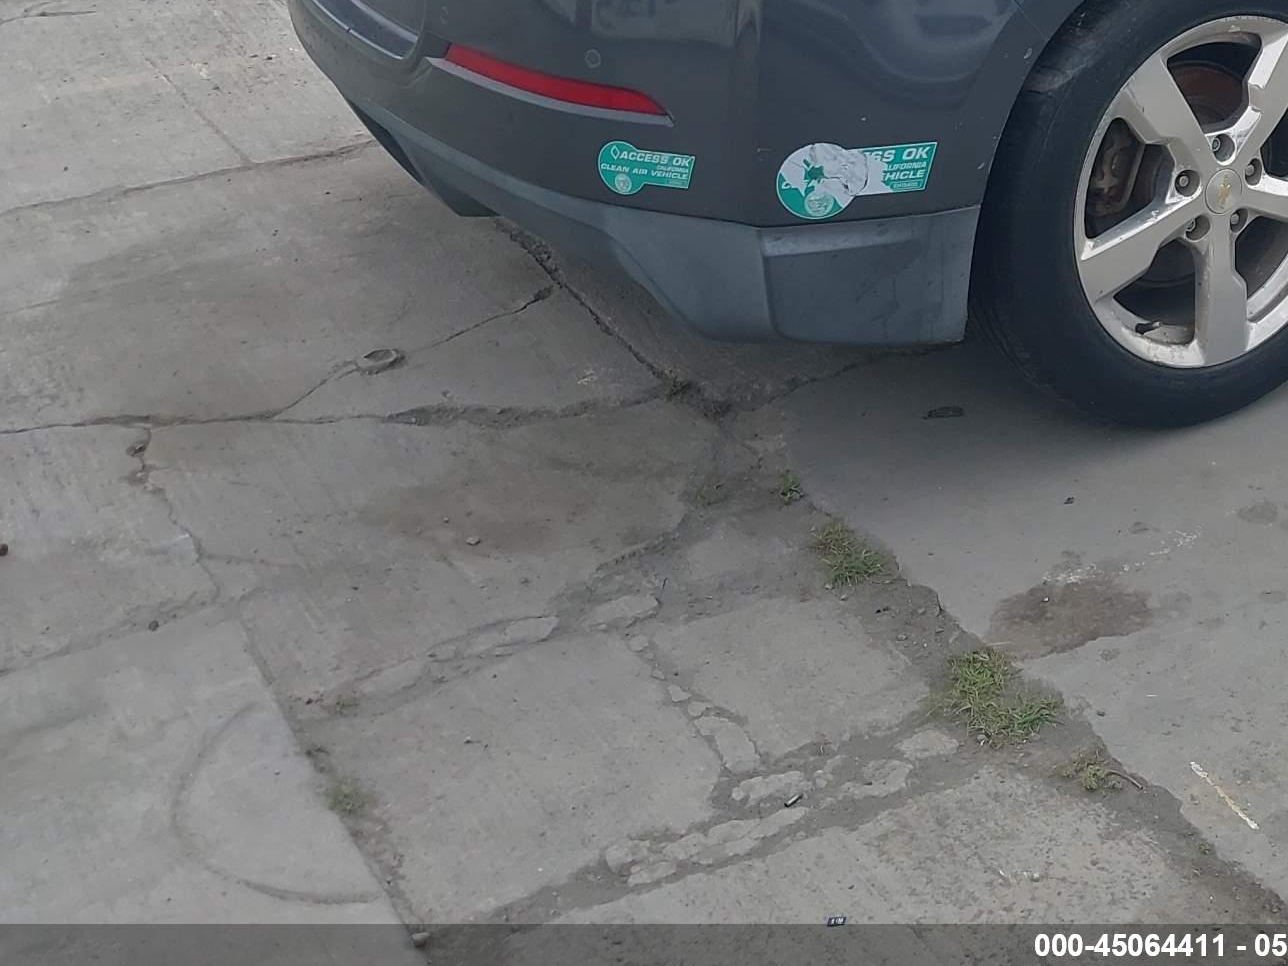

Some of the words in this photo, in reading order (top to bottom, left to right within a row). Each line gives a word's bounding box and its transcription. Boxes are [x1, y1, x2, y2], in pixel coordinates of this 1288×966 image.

[620, 151, 669, 164] ACCESS
[672, 156, 691, 166] OK
[902, 147, 931, 160] OK
[600, 163, 630, 172] CLEAN
[651, 170, 688, 180] VEHICLE
